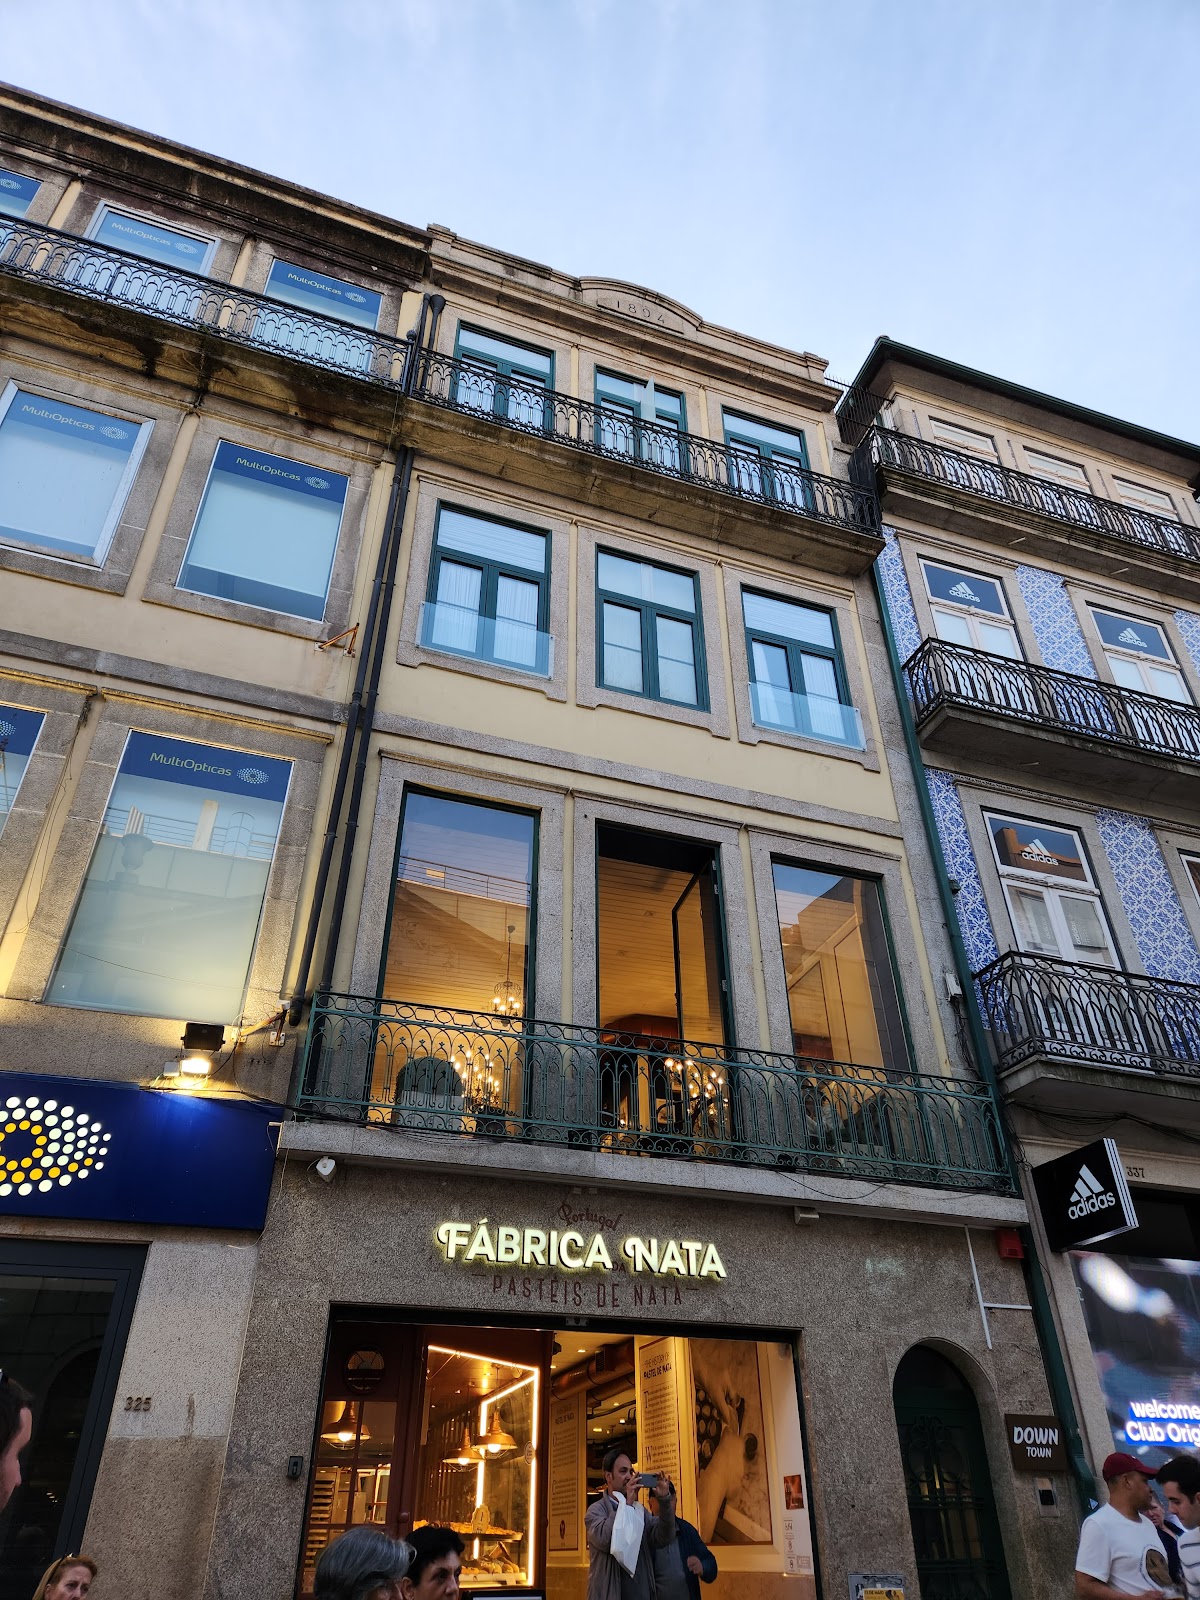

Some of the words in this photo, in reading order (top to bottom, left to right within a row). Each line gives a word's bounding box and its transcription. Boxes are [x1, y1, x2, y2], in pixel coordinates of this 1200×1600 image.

[111, 222, 171, 246] MultiOpticas
[287, 273, 342, 296] MultiOpticas
[21, 404, 96, 432] MultiOpticas
[235, 457, 301, 481] MultiOpticas
[948, 588, 981, 603] adidas
[1118, 634, 1148, 648] adidas
[149, 752, 232, 777] MultiOpticas
[1021, 851, 1059, 866] adidas
[1125, 1166, 1145, 1178] 337
[558, 1201, 623, 1232] Portugal
[1068, 1191, 1116, 1220] adidas
[437, 1217, 613, 1270] FÁBRICA
[624, 1236, 727, 1279] NATA
[493, 1274, 582, 1307] PASTÉIS
[597, 1282, 620, 1308] DE
[634, 1283, 682, 1307] NATA
[124, 1396, 151, 1411] 325
[1129, 1398, 1200, 1420] welcome
[1013, 1426, 1059, 1445] DOWN
[1125, 1420, 1165, 1442] Club
[1167, 1422, 1200, 1447] Orig
[1026, 1446, 1052, 1458] TOWN
